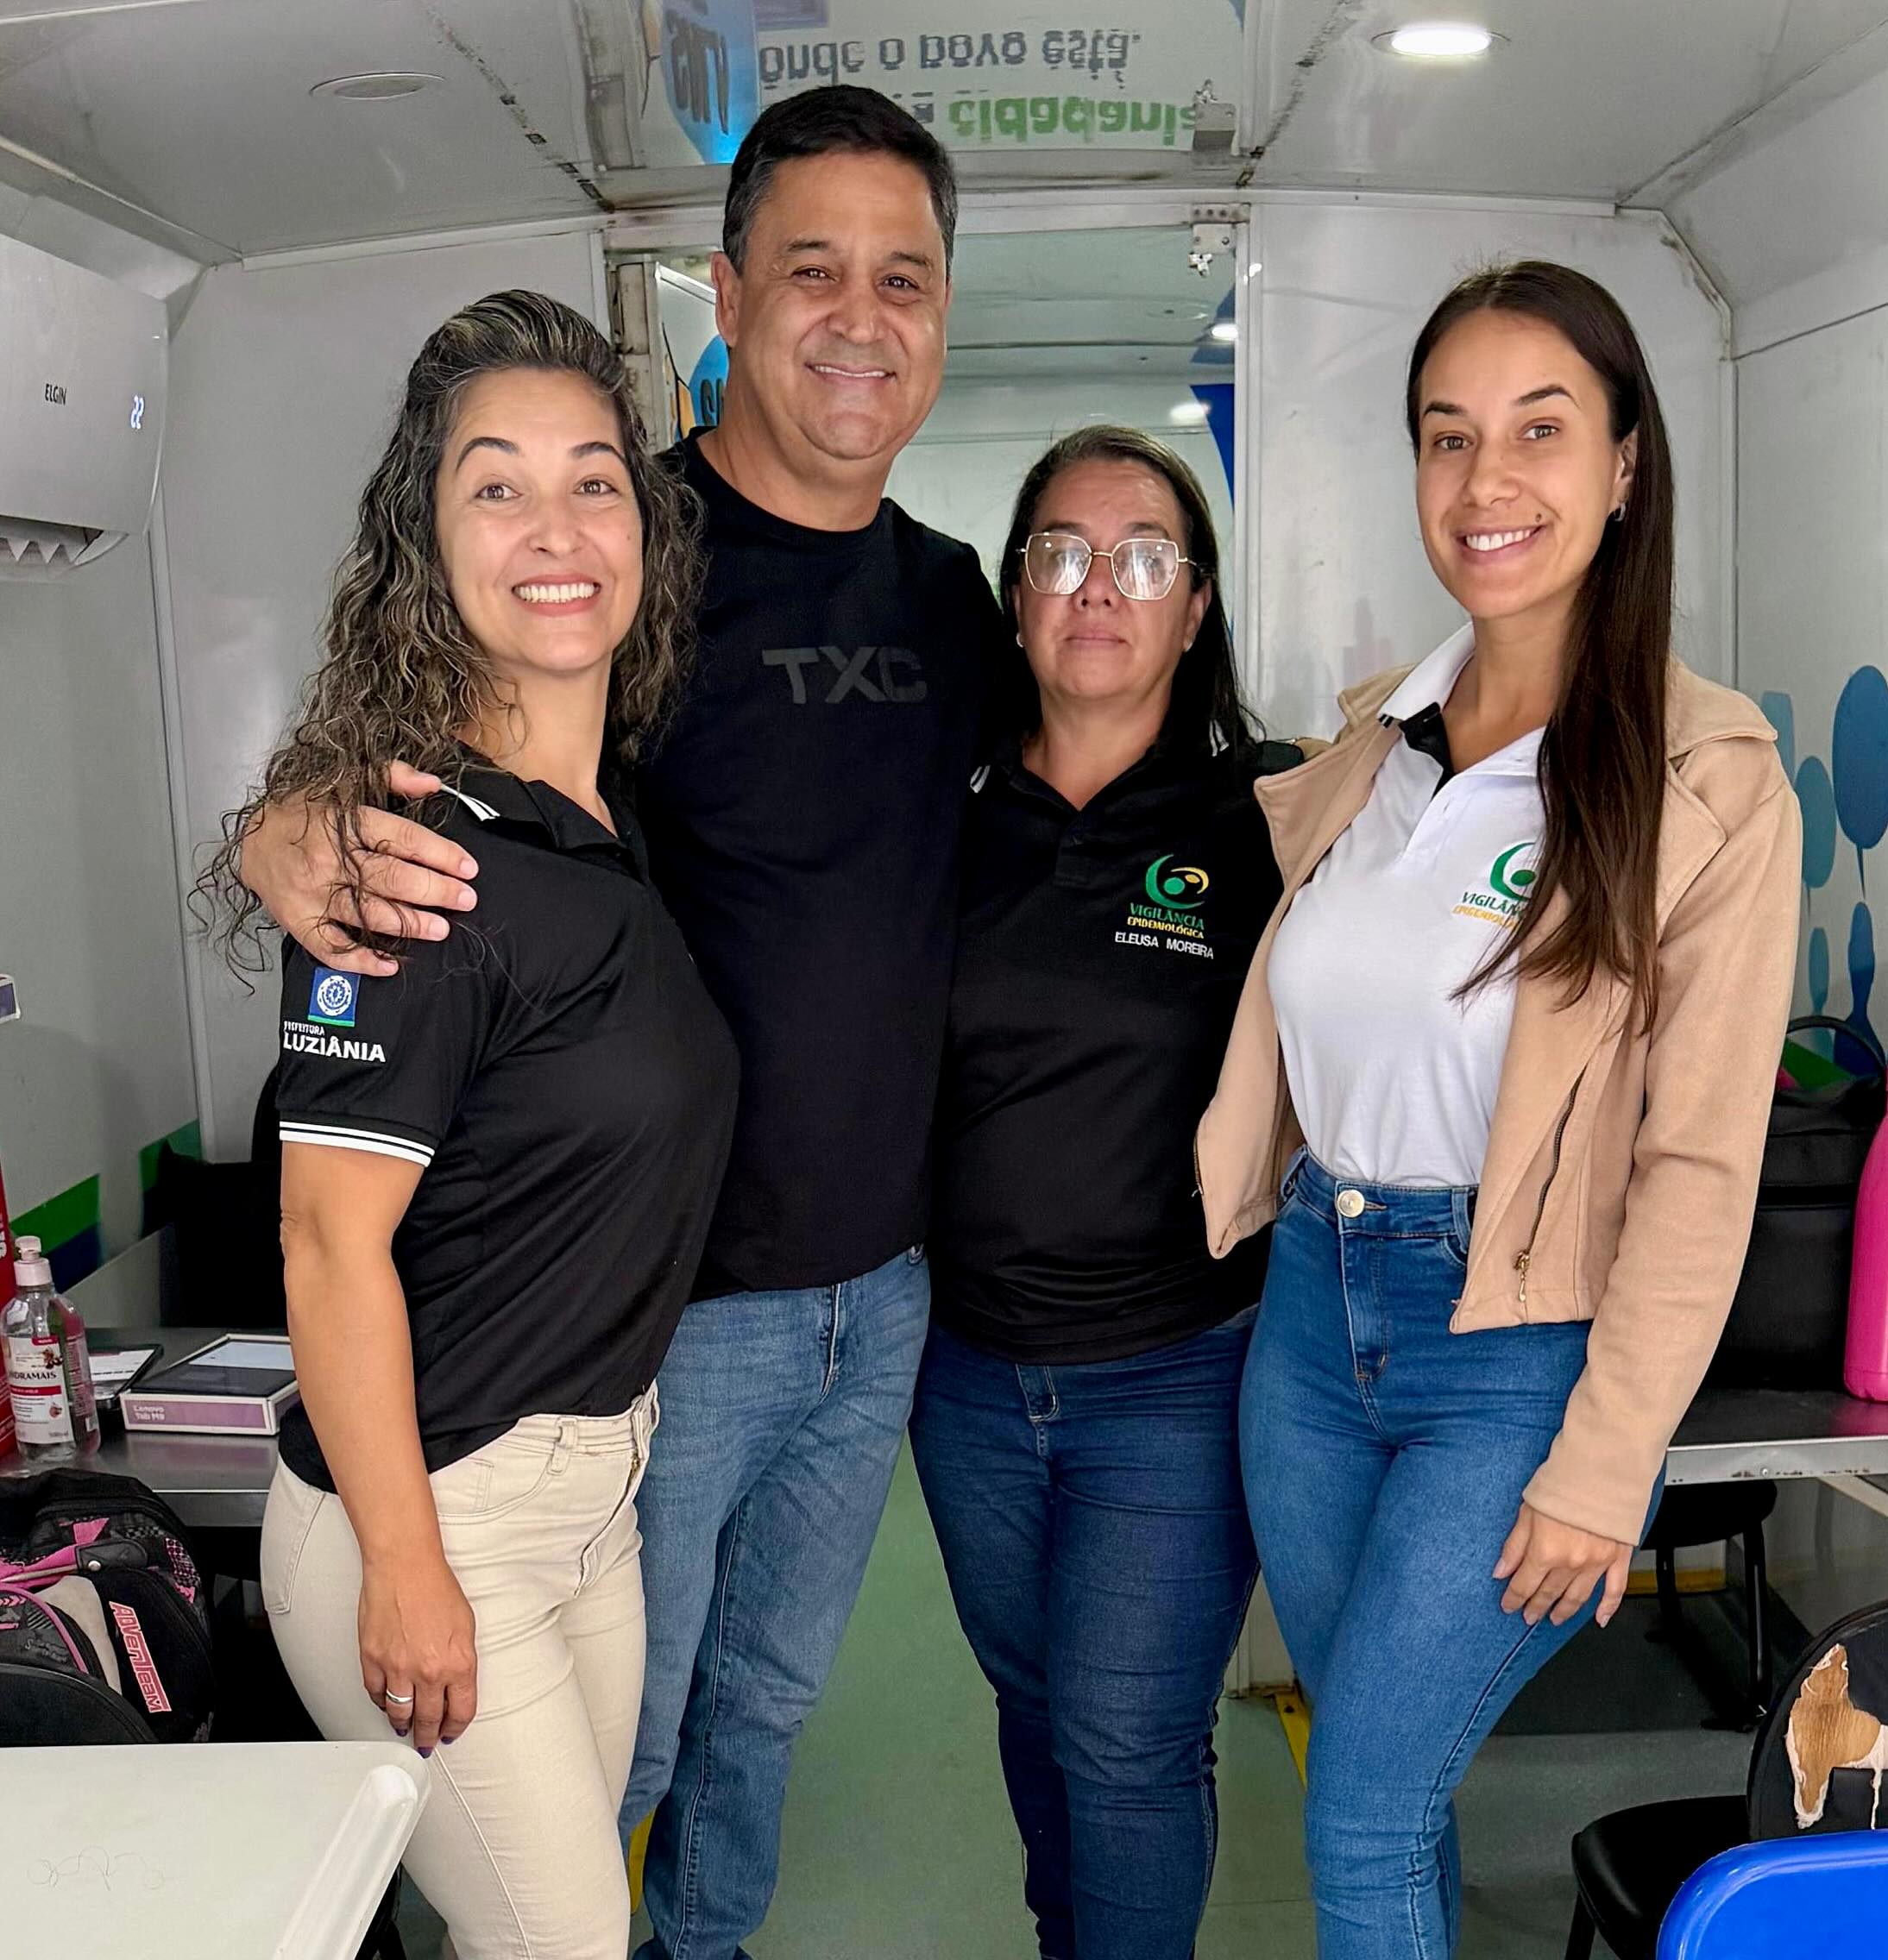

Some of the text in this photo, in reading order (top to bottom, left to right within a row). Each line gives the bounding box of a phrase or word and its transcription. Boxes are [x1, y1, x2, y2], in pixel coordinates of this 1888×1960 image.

[45, 383, 67, 405] ELGIN
[130, 394, 145, 430] 22
[762, 645, 928, 704] TXC
[1126, 916, 1205, 939] EPIDEMIOLÓGICA
[1114, 931, 1214, 960] ELEUSA MOREIRA
[283, 1032, 386, 1063] LUZIÂNIA
[132, 1404, 165, 1413] Lenovo
